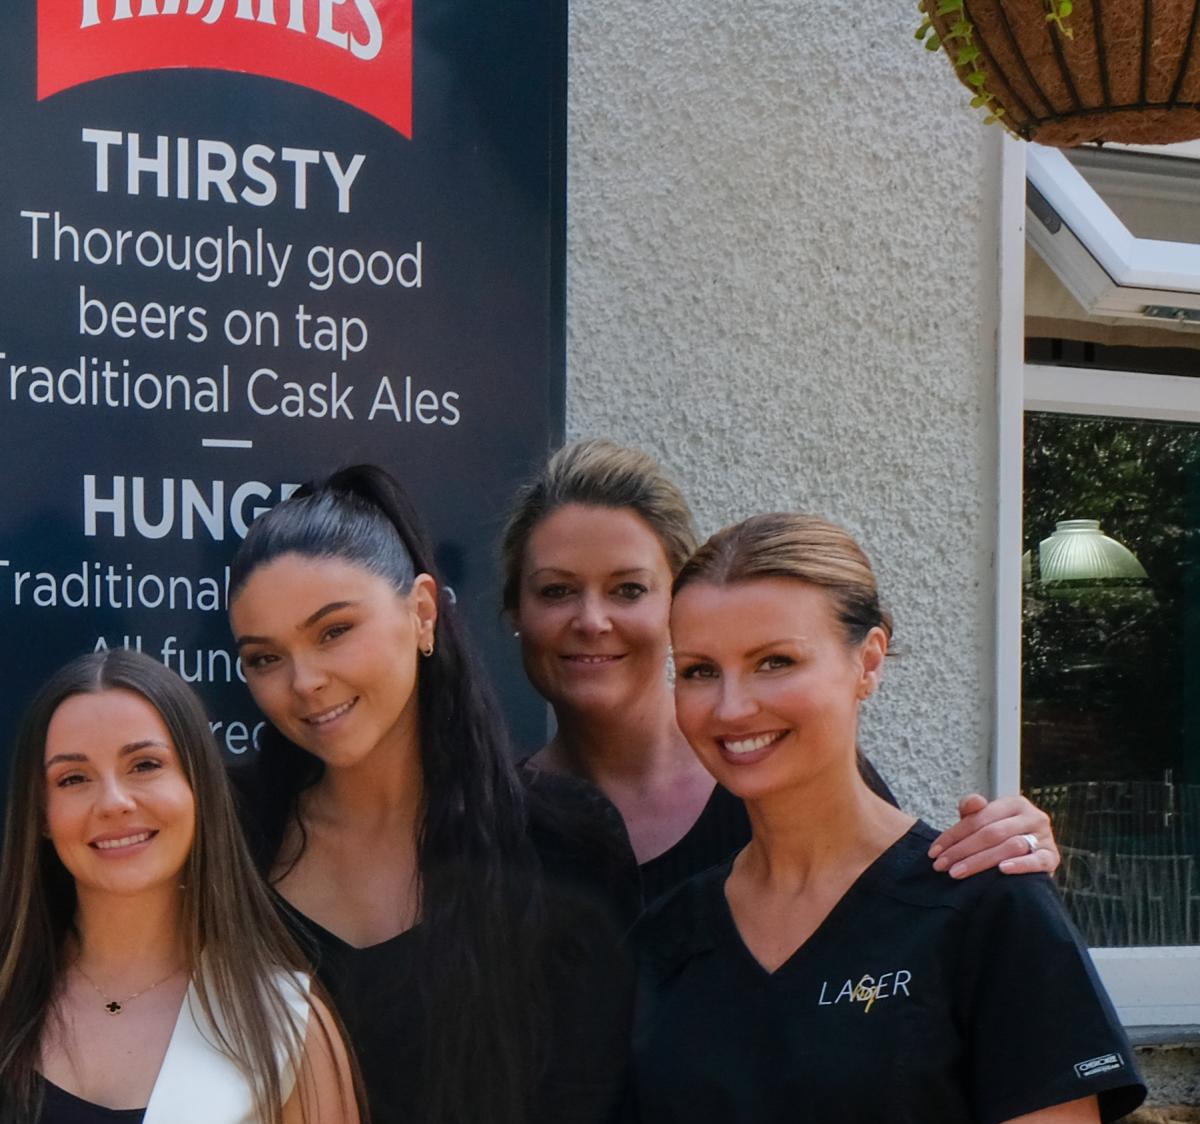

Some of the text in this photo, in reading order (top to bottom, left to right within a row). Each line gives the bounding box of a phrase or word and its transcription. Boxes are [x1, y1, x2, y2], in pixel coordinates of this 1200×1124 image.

[82, 128, 366, 213] THIRSTY
[20, 210, 422, 290] Thoroughly good
[80, 285, 368, 360] beers on tap
[248, 368, 354, 421] Cask
[368, 376, 460, 426] Ales
[83, 474, 303, 541] HUNG
[818, 970, 911, 1006] LASER
